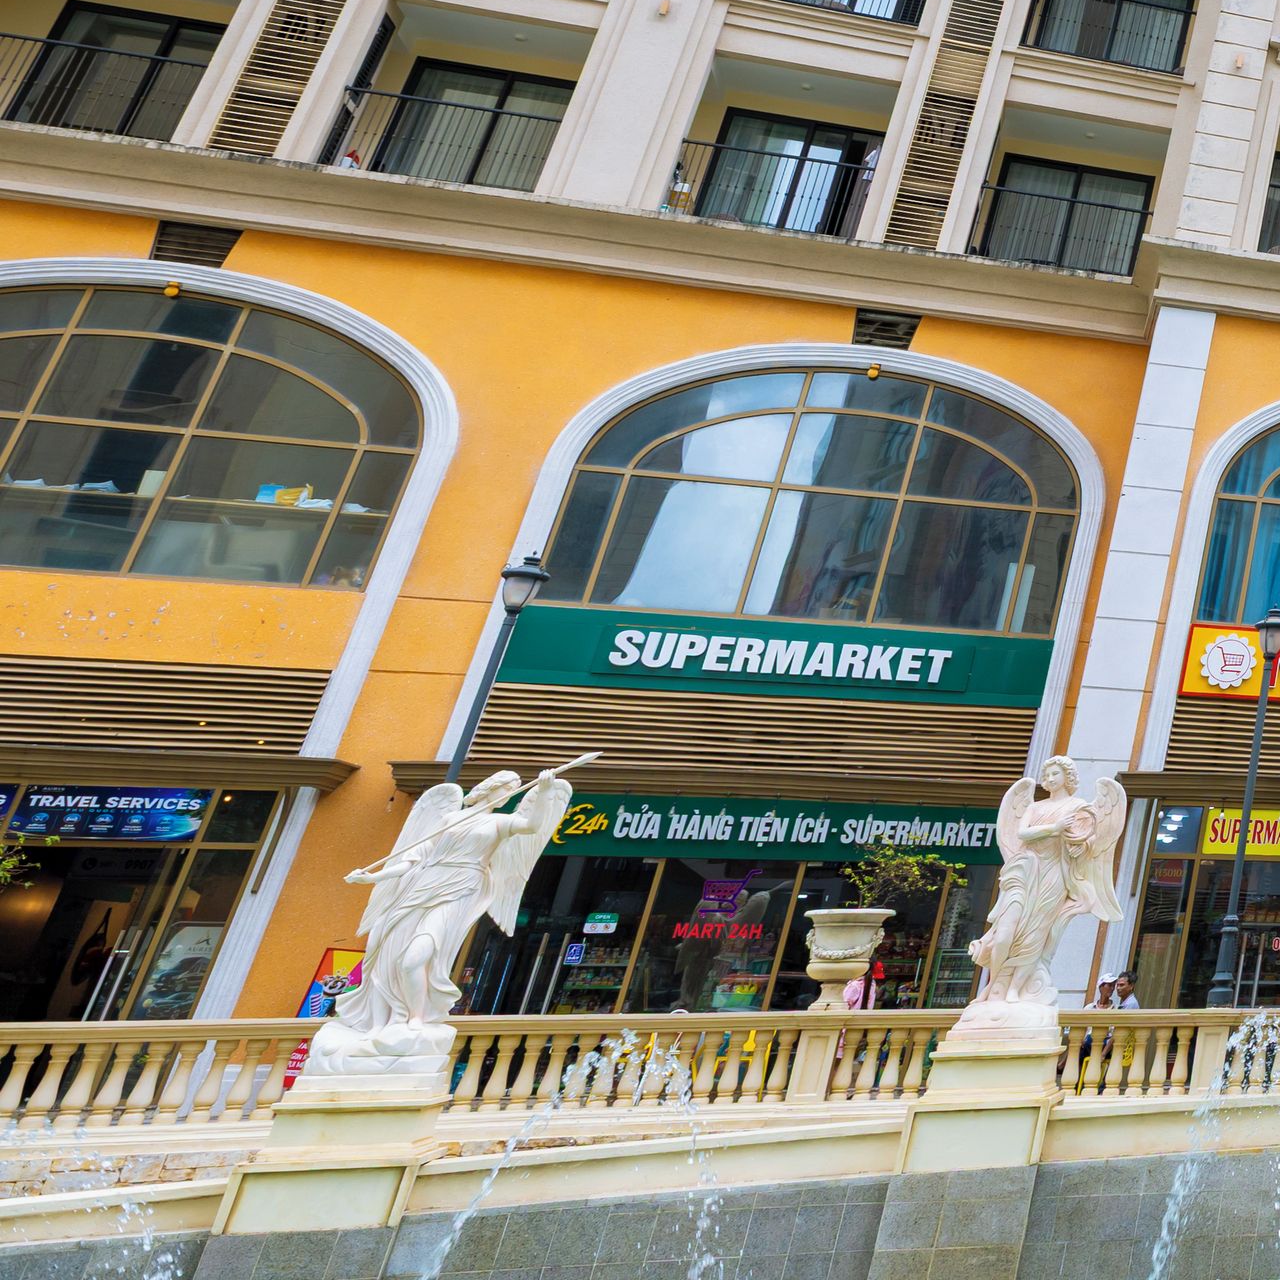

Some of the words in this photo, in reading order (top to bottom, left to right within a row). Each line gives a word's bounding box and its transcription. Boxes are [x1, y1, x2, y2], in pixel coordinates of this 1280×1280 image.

[608, 629, 953, 683] SUPERMARKET
[29, 795, 100, 808] TRAVEL
[105, 796, 201, 811] SERVICES
[564, 813, 609, 835] 24h
[613, 804, 660, 840] CỬA
[667, 809, 734, 841] HÀNG
[738, 811, 790, 847] TIỆN
[790, 812, 831, 843] ÍCH
[840, 817, 997, 847] SUPERMARKET
[672, 922, 726, 939] MART
[727, 923, 763, 939] 24H
